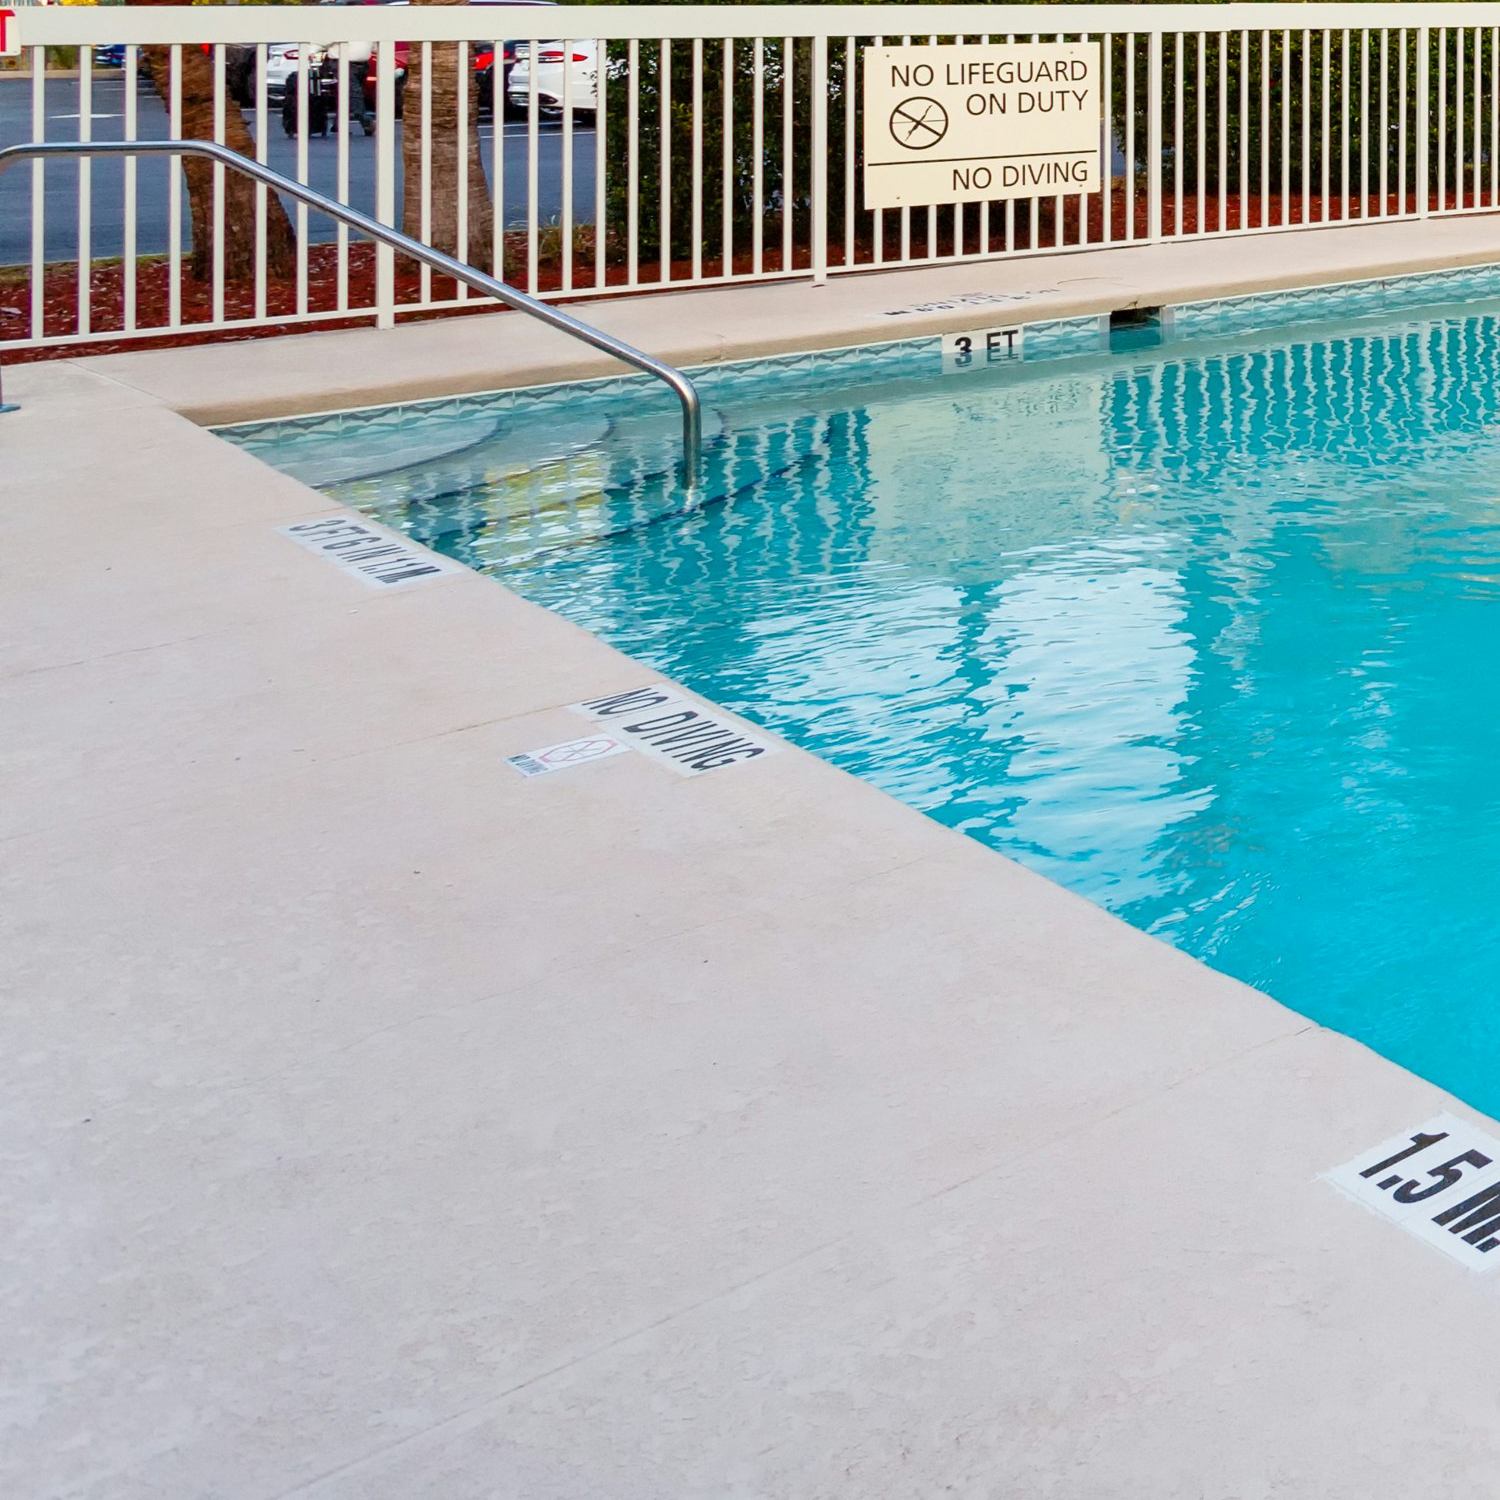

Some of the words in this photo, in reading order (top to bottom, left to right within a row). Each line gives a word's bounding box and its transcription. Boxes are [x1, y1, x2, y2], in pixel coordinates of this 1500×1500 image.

[891, 64, 934, 87] NO
[946, 60, 1088, 86] LIFEGUARD
[966, 93, 1006, 116] ON
[1018, 90, 1089, 114] DUTY
[953, 167, 992, 191] NO
[1003, 161, 1088, 187] DIVING
[954, 337, 972, 353] 3
[987, 329, 1019, 351] FT
[289, 519, 347, 531] 3
[300, 525, 370, 542] FT
[322, 536, 382, 550] 6
[336, 543, 408, 563] IN
[581, 687, 669, 716] NO
[622, 710, 765, 772] DIVING
[1359, 1130, 1493, 1204] 1.5
